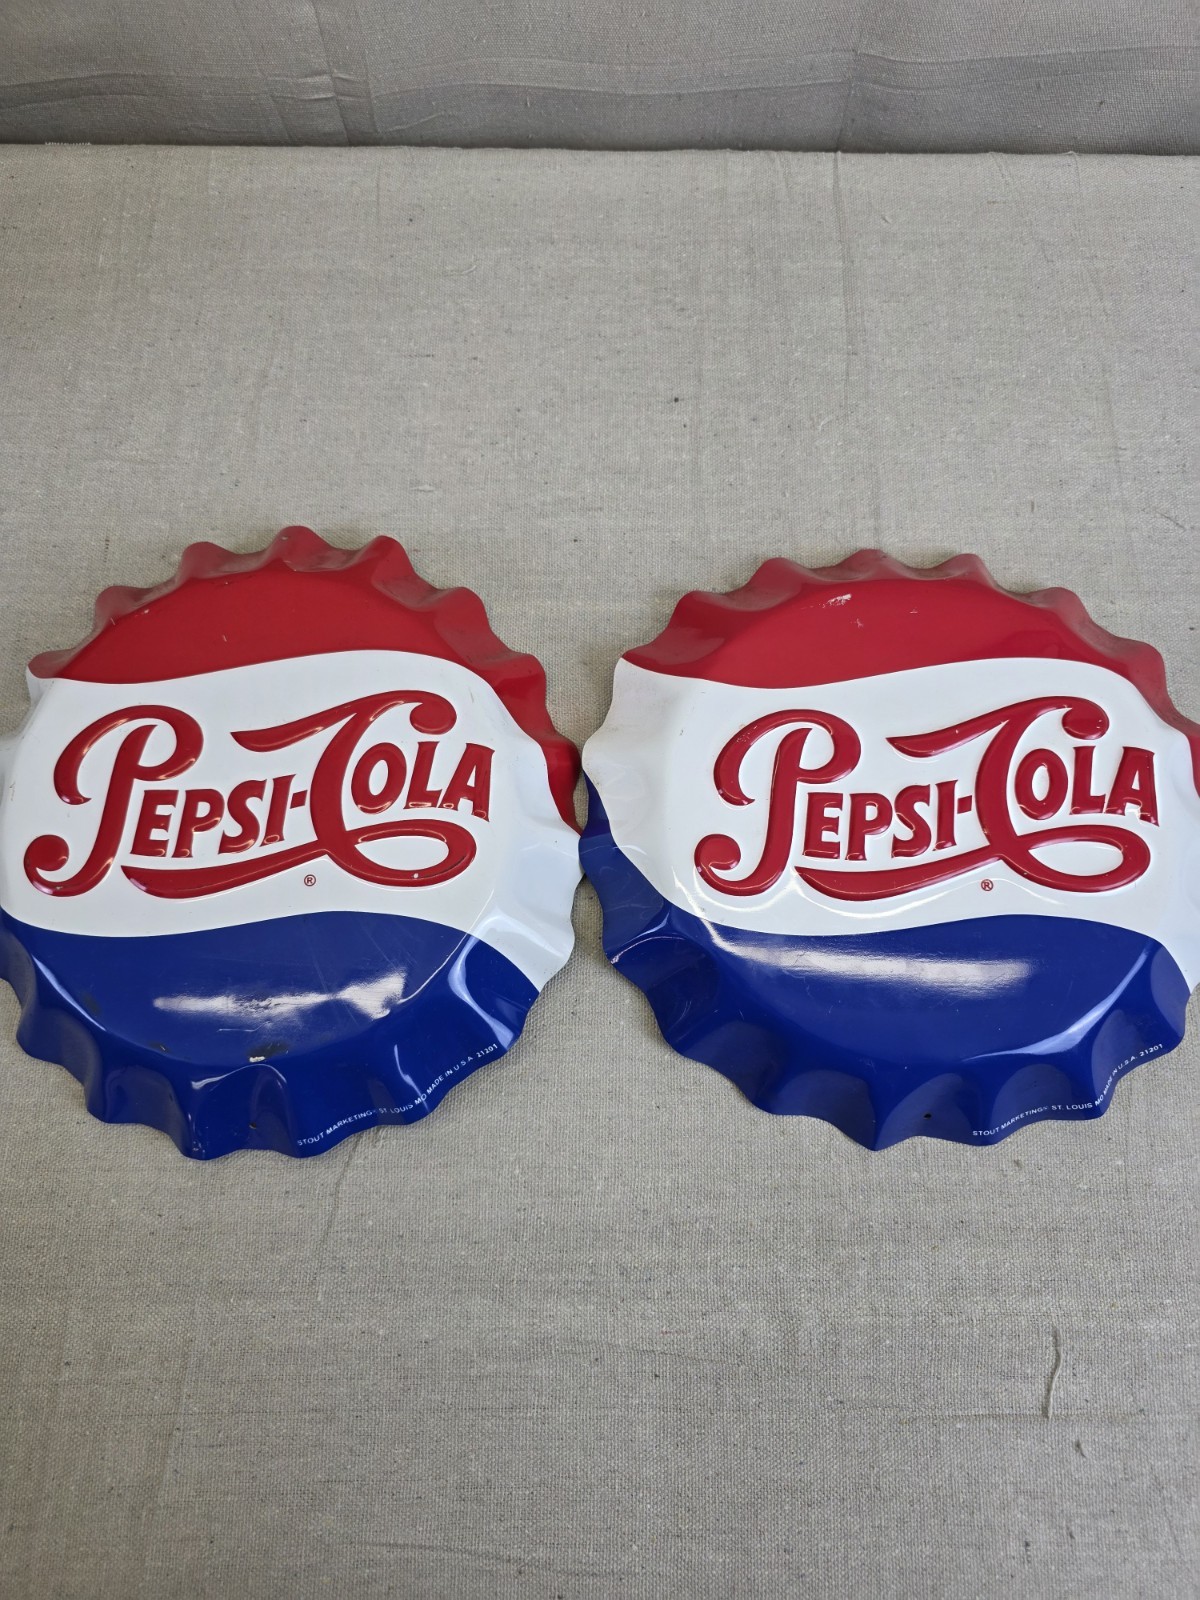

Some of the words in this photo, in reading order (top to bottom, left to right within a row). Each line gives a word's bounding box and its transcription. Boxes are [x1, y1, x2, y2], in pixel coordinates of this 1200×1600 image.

[297, 1131, 324, 1146] STOUT
[390, 1104, 414, 1114] LOUIS
[426, 1075, 444, 1095] MADE
[445, 1068, 453, 1077] IN
[476, 1043, 498, 1058] 21201
[972, 1126, 1000, 1136] STOUT
[1066, 1102, 1093, 1110] LOUIS
[1139, 1043, 1163, 1057] 21201
